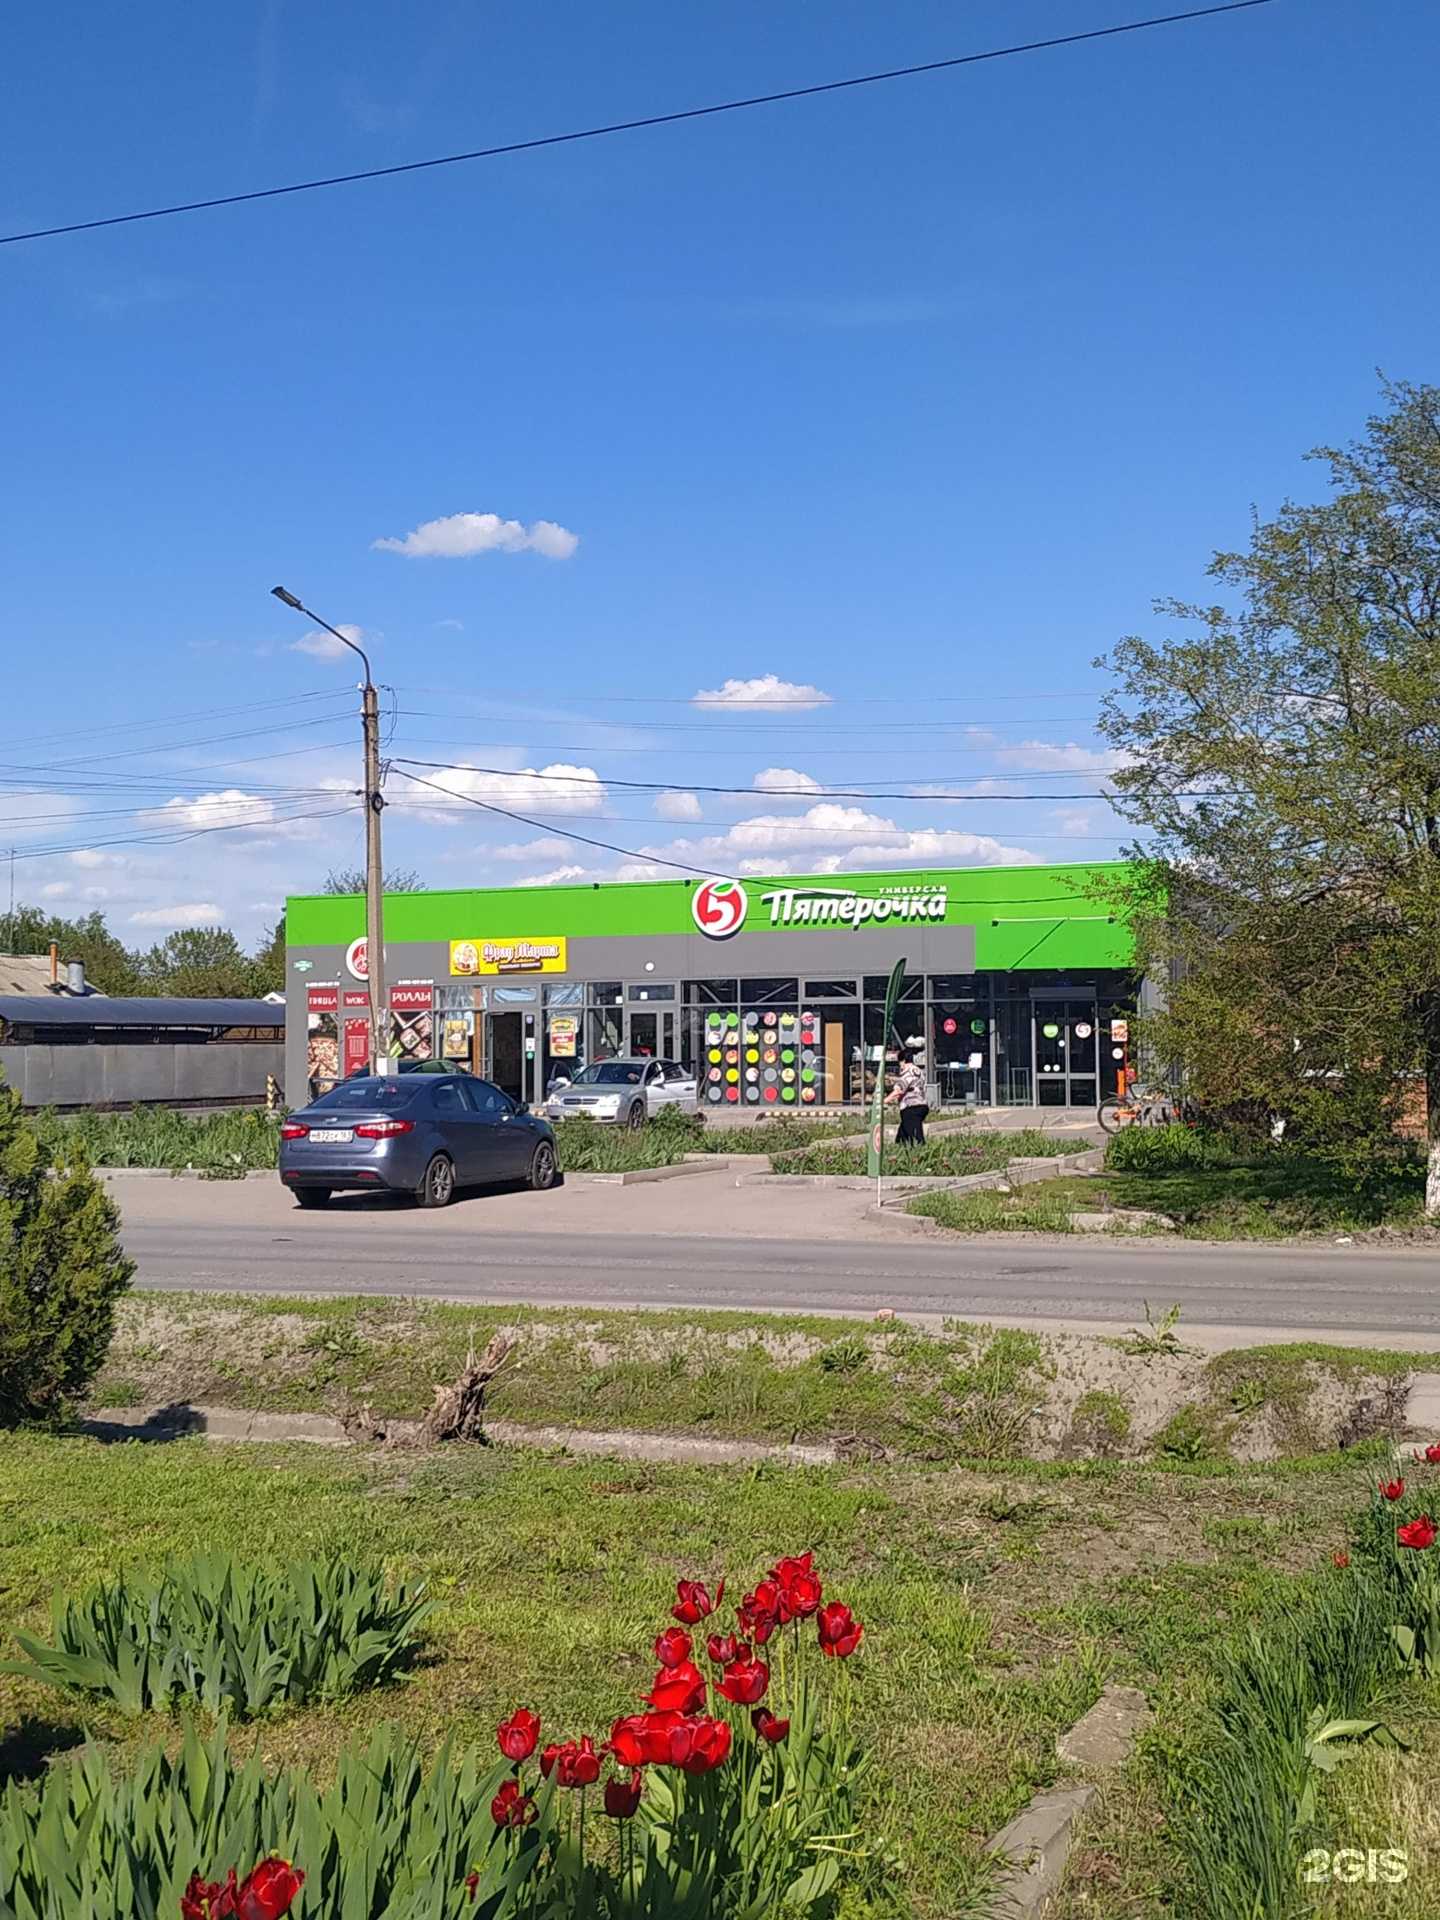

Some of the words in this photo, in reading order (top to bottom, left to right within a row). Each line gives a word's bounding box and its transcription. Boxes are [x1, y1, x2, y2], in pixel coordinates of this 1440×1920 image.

[879, 885, 947, 894] УНИВЕРСАМ
[701, 880, 742, 934] 5
[346, 997, 365, 1005] WOK
[392, 992, 431, 1003] РОЛЛЫ
